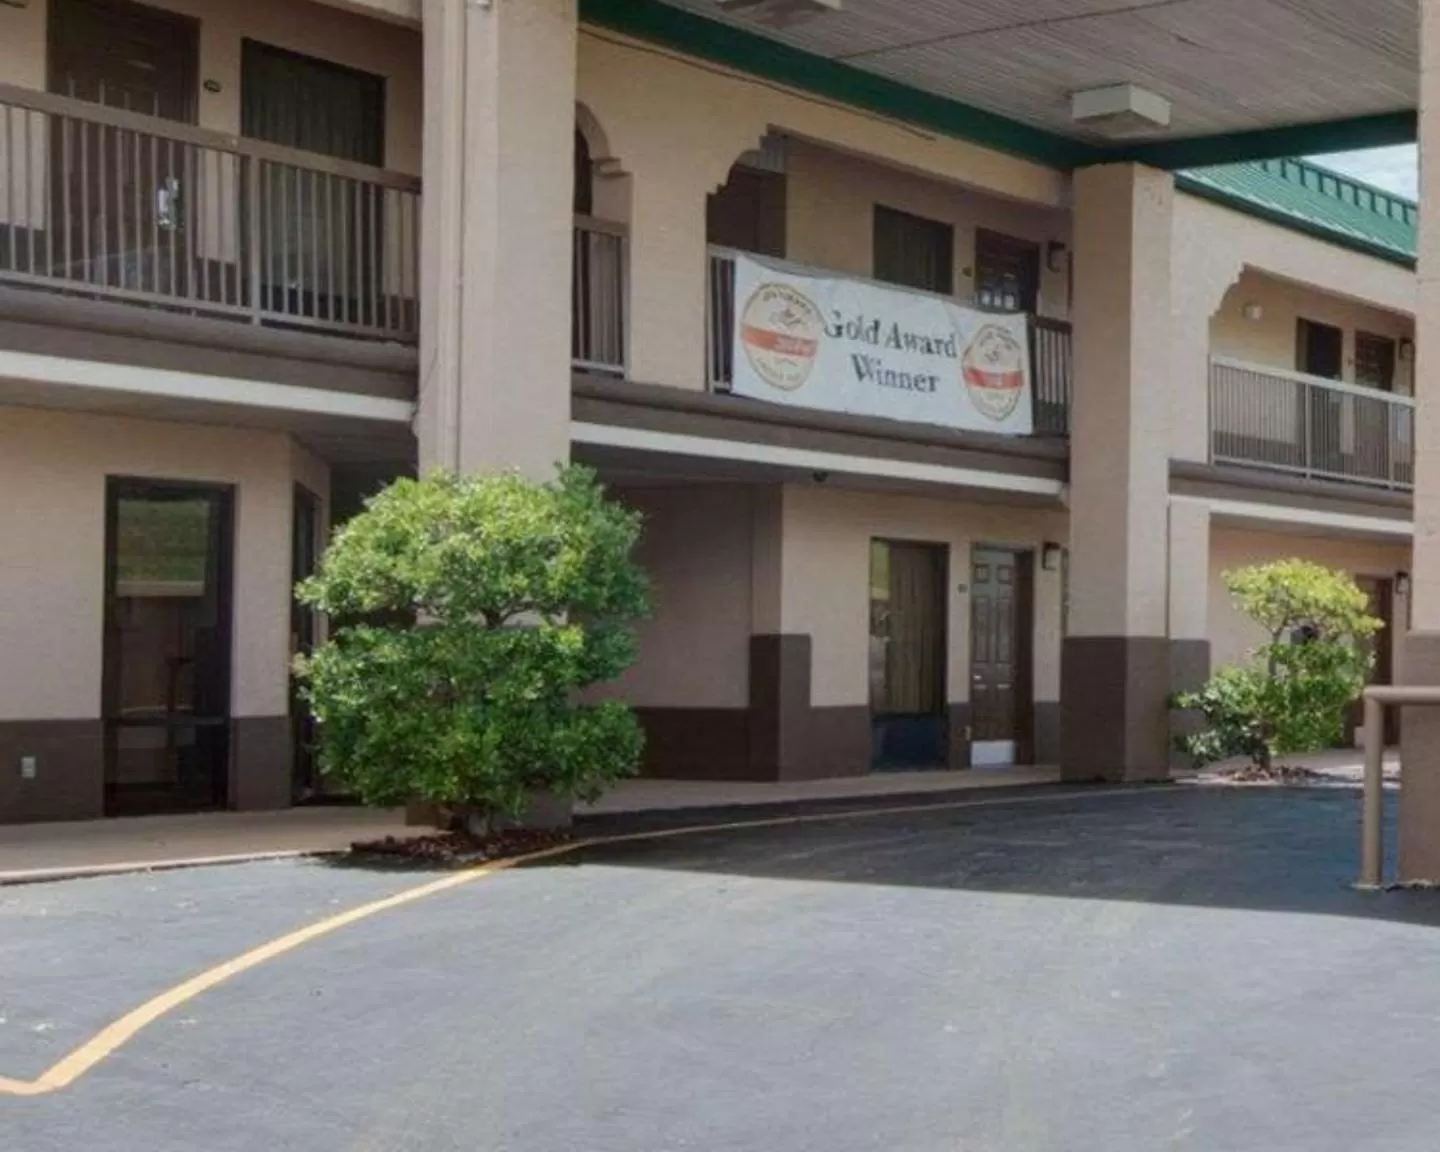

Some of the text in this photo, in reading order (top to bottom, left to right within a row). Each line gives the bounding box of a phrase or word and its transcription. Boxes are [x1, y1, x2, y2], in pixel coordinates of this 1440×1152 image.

[823, 309, 880, 346] Gold
[885, 322, 958, 358] Award
[850, 354, 940, 393] Winner
